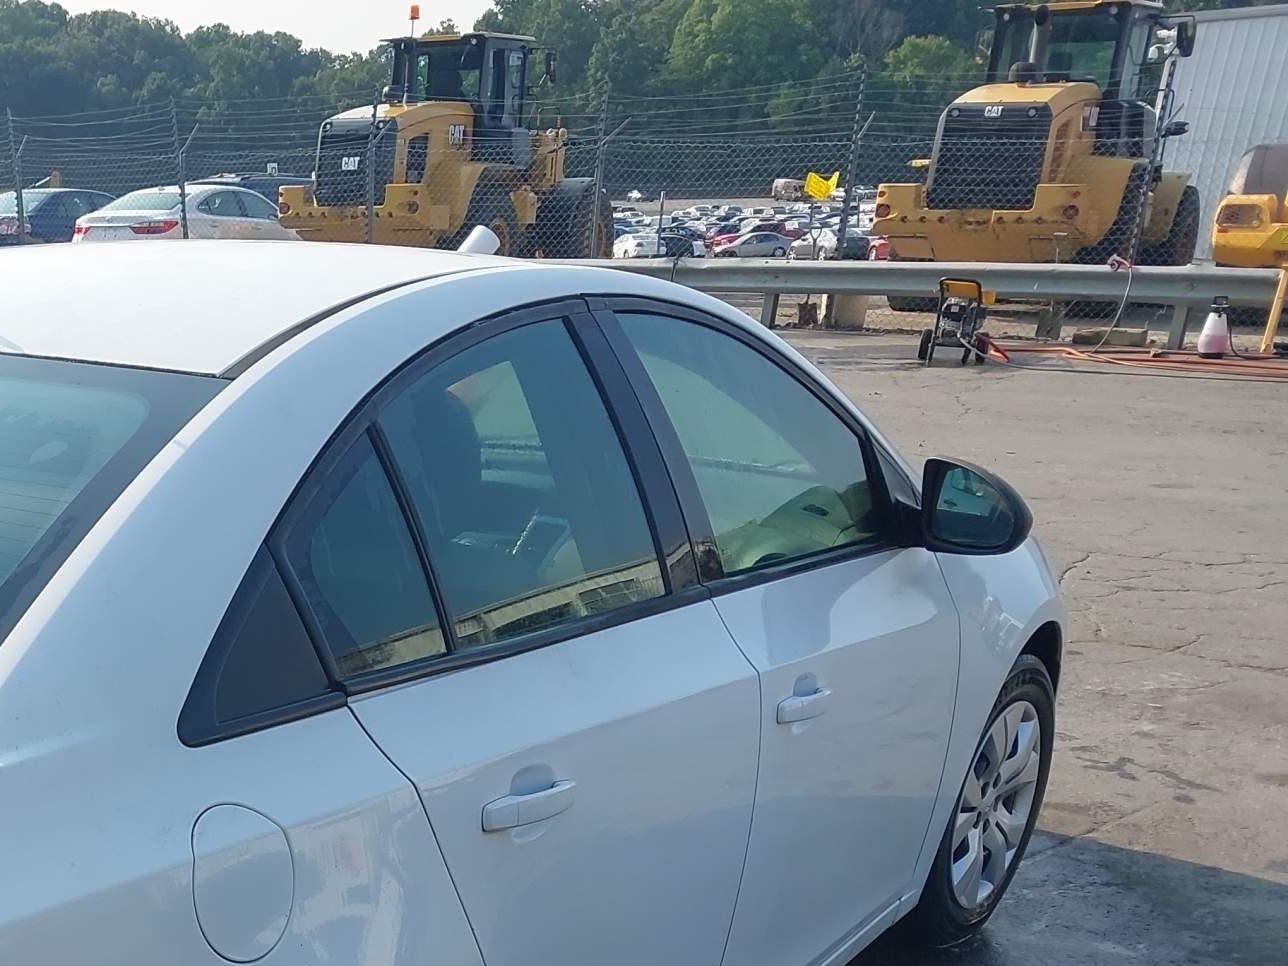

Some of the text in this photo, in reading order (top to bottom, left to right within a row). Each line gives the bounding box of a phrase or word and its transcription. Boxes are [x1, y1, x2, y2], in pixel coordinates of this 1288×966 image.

[984, 106, 1005, 117] CAT
[448, 125, 465, 145] CAT
[341, 157, 361, 170] CAT
